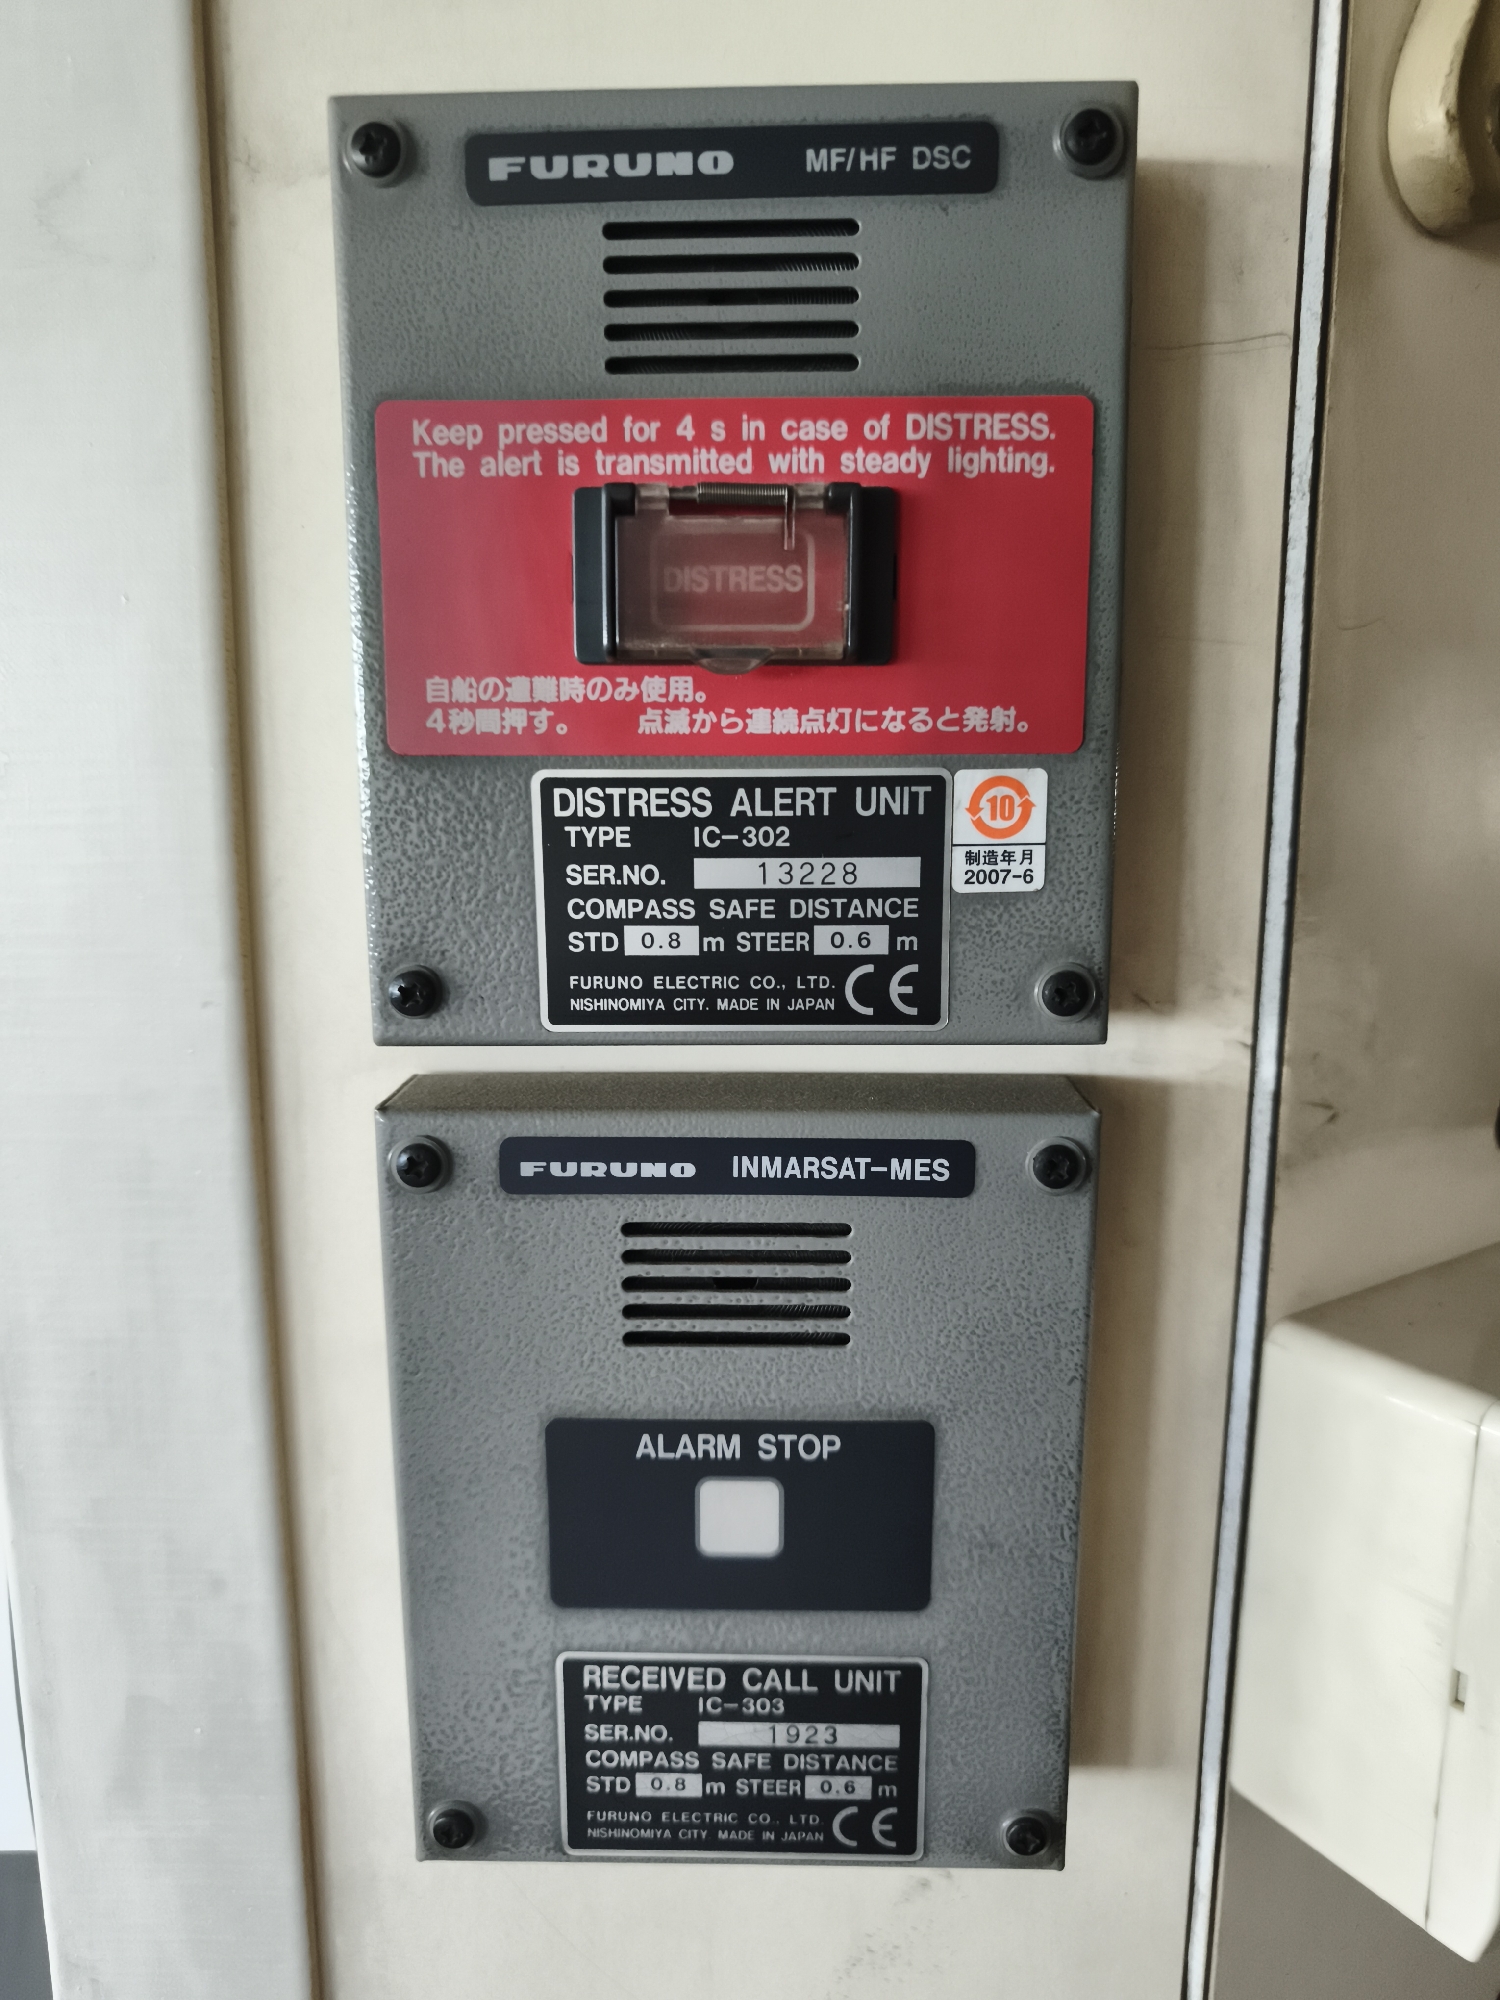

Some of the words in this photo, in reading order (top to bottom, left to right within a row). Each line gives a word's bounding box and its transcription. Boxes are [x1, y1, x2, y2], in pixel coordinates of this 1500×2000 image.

[488, 150, 734, 182] FURUNO
[805, 146, 896, 173] MF/HF
[912, 145, 971, 170] DSC
[413, 419, 483, 451] Keep
[498, 417, 608, 450] pressed
[623, 417, 660, 443] for
[676, 416, 695, 441] 4
[710, 421, 725, 441] s
[742, 416, 765, 440] in
[781, 419, 848, 440] case
[864, 415, 890, 440] of
[906, 414, 1056, 441] DISTRESS.
[415, 453, 465, 478] The
[480, 452, 542, 477] alert
[557, 452, 580, 476] is
[595, 450, 753, 476] transmitted
[769, 450, 824, 475] with
[840, 450, 931, 481] steady
[947, 448, 1056, 481] lighting.
[664, 565, 804, 592] DISTRESS
[554, 787, 712, 818] DISTRESS
[730, 786, 837, 817] ALERT
[856, 786, 932, 816] UNIT
[985, 795, 1012, 822] 10
[565, 827, 631, 847] TYPE
[694, 826, 790, 847] IC-302
[964, 850, 1034, 866] 制造年月
[565, 864, 665, 885] SER.NO.
[758, 862, 859, 885] 13228
[964, 868, 1034, 885] 2007-6
[567, 899, 696, 919] COMPASS
[709, 899, 776, 919] SAFE
[790, 898, 919, 918] DISTANCE
[568, 932, 618, 952] STD
[640, 932, 681, 949] 0.8
[703, 936, 725, 952] m
[737, 932, 810, 951] STEER
[830, 932, 872, 949] 0.6
[897, 935, 918, 951] m
[569, 975, 643, 989] FURUNO
[653, 975, 740, 989] ELECTRIC
[750, 975, 786, 992] CO.,
[797, 975, 835, 989] LTD.
[570, 998, 665, 1012] NISHINOMIYA
[673, 998, 709, 1012] CITY.
[716, 998, 760, 1012] MADE
[767, 998, 780, 1011] IN
[787, 998, 835, 1011] JAPAN
[519, 1161, 696, 1177] FURUNO
[732, 1156, 950, 1182] INMARSAT-MES
[636, 1434, 740, 1460] ALARM
[758, 1434, 841, 1460] STOP
[583, 1665, 726, 1691] RECEIVED
[742, 1668, 818, 1693] CALL
[834, 1670, 901, 1693] UNIT
[584, 1694, 642, 1713] TYPE
[699, 1697, 785, 1716] IC-303
[584, 1724, 673, 1743] SER.NO.
[770, 1725, 838, 1744] 1923
[586, 1751, 699, 1769] COMPASS
[712, 1753, 771, 1771] SAFE
[784, 1754, 898, 1772] DISTANCE
[586, 1776, 631, 1793] STD
[650, 1777, 686, 1791] 0.8
[706, 1781, 725, 1794] m
[736, 1778, 801, 1796] STEER
[820, 1780, 856, 1794] 0.6
[879, 1783, 897, 1797] m
[587, 1811, 652, 1823] FURUNO
[662, 1812, 738, 1824] ELECTRIC
[789, 1814, 824, 1825] LTD.
[587, 1827, 672, 1840] NISHINOMIYA
[718, 1830, 757, 1841] MADE
[762, 1830, 774, 1841] IN
[781, 1830, 824, 1842] JAPAN
